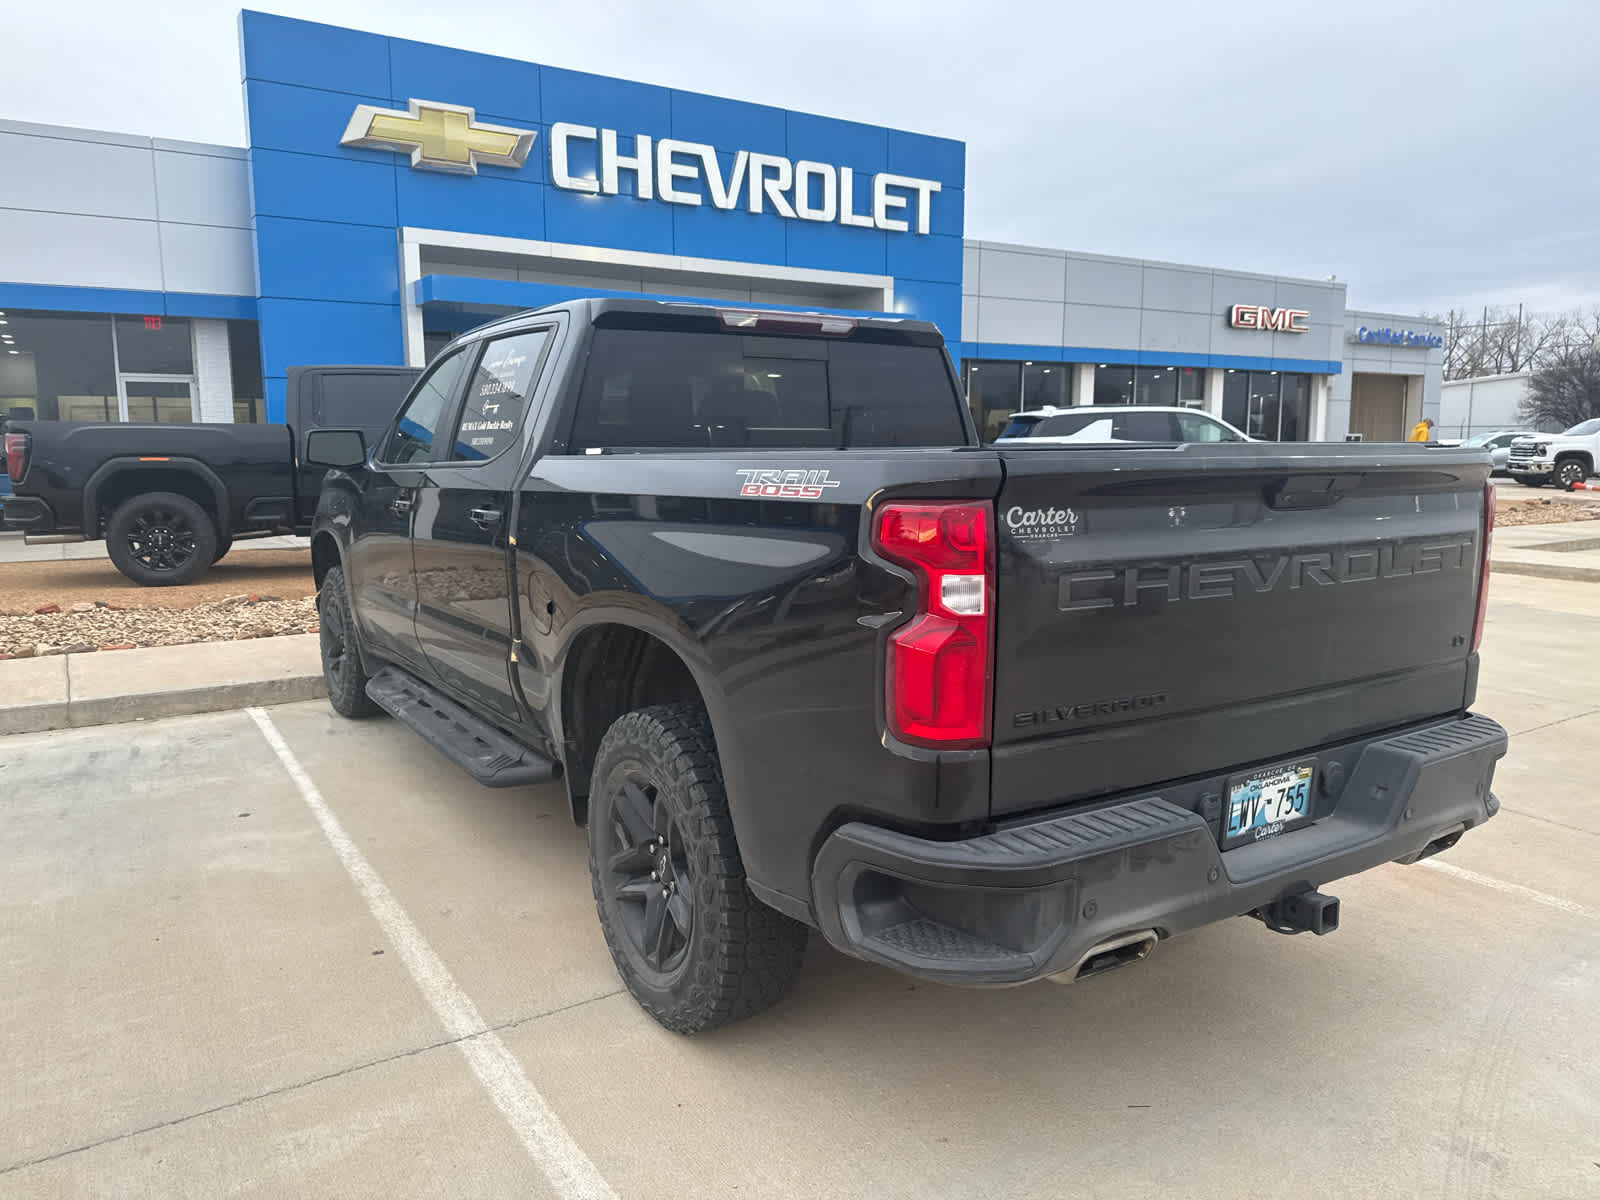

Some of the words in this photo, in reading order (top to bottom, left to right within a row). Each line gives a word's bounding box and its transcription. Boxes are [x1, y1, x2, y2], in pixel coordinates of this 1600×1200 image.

[550, 121, 942, 235] CHEVROLET
[1231, 304, 1310, 332] GMC
[1358, 325, 1404, 345] Certified
[1407, 330, 1443, 348] Service
[736, 470, 840, 487] TRAIL
[740, 484, 824, 499] BOSS
[1006, 506, 1078, 528] Carter
[1010, 525, 1075, 535] CHEVROLET
[1057, 538, 1472, 611] CHEVROLET
[1013, 691, 1167, 728] SILVERADO
[1249, 776, 1290, 792] OKLAHOMA
[1254, 821, 1284, 838] Carter
